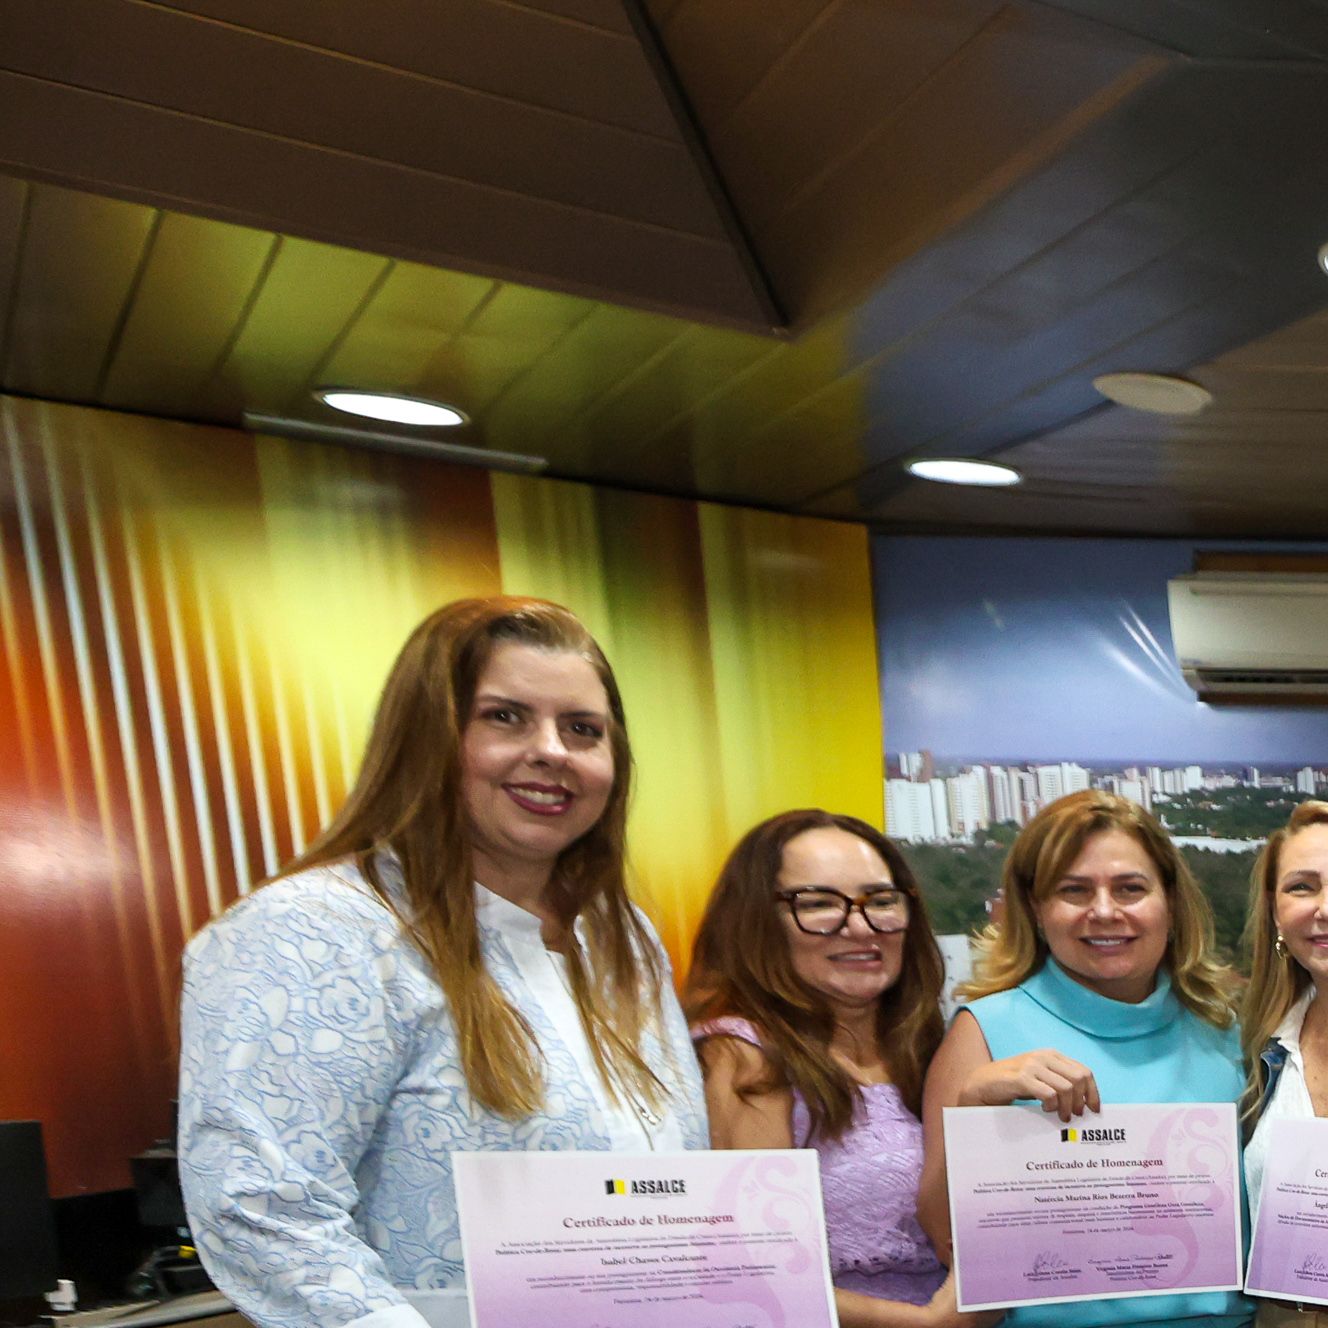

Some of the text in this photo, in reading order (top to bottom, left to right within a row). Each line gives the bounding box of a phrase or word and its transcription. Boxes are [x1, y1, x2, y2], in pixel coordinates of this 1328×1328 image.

[1081, 1129, 1126, 1141] ASSALCE
[1026, 1159, 1163, 1171] Certificado de Homenagem
[631, 1179, 686, 1194] ASSALCE
[562, 1215, 734, 1229] Certificado de Homenagem
